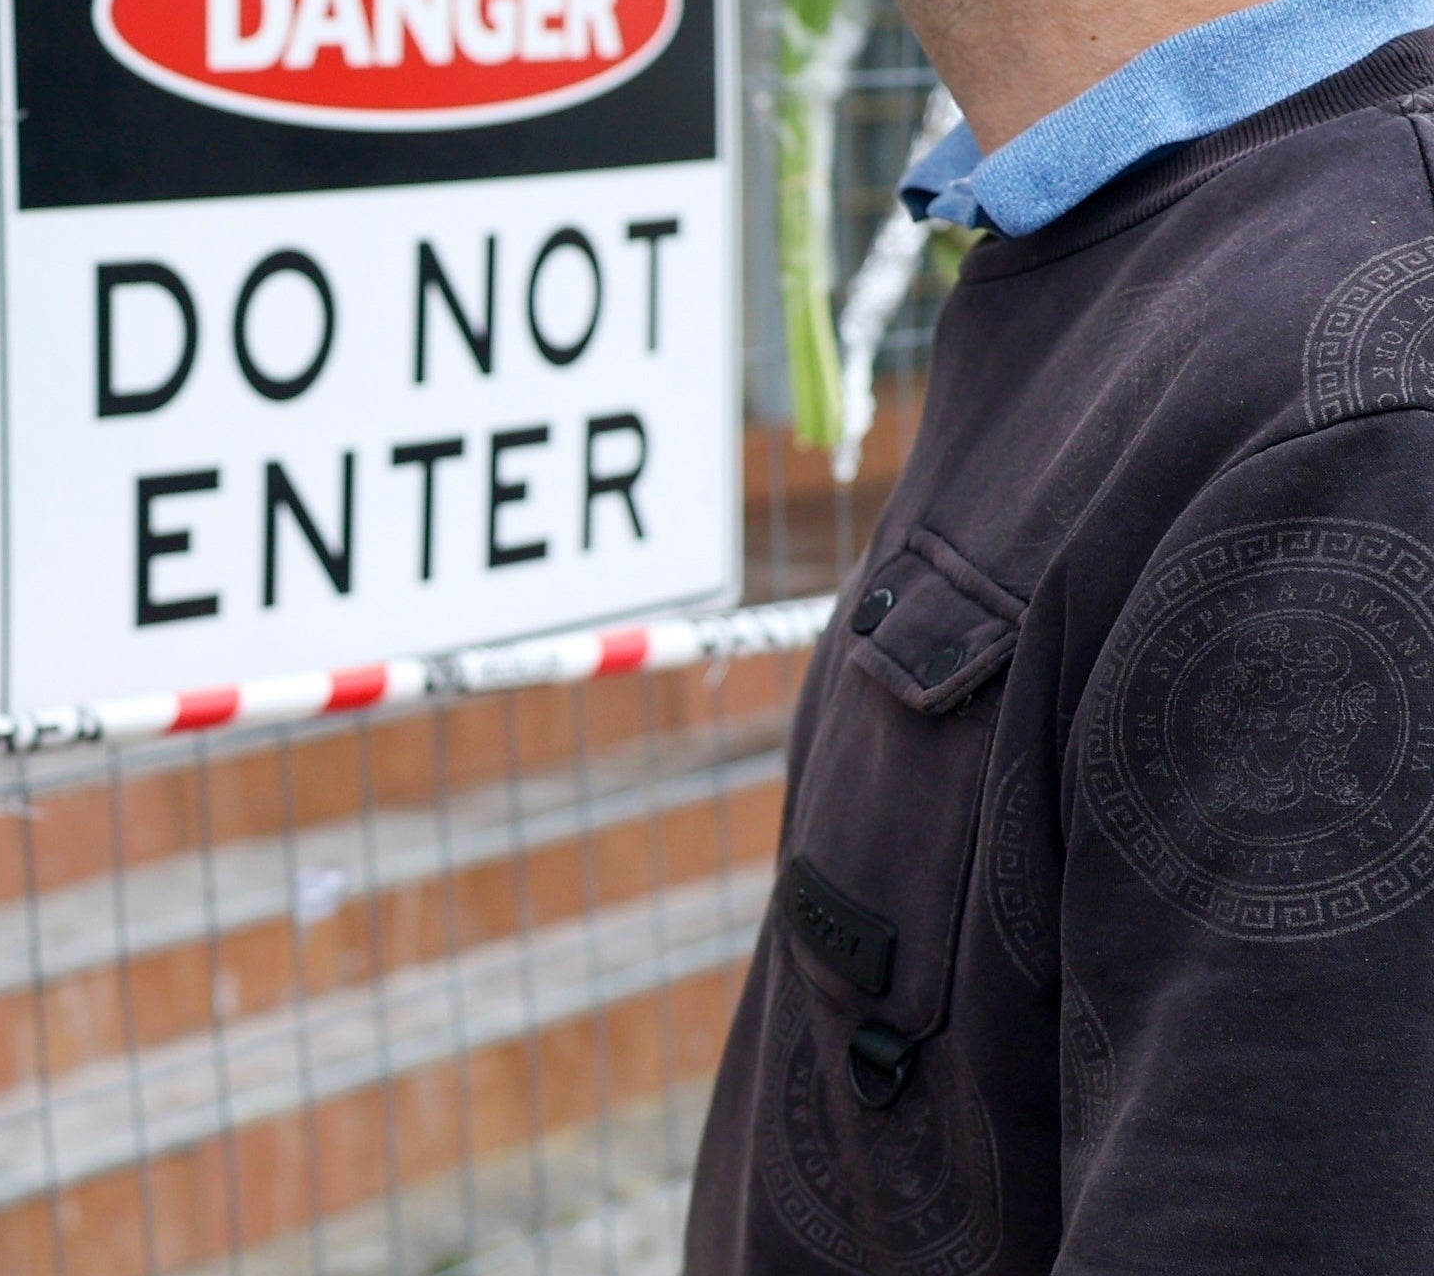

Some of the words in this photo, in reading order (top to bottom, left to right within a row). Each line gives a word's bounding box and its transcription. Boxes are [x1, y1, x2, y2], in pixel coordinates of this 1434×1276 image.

[93, 246, 336, 419] DO
[414, 217, 682, 387] NOT
[1373, 316, 1414, 380] YORK
[134, 411, 648, 630] ENTER
[1150, 589, 1258, 681] SUPPLY
[1277, 583, 1298, 603] &
[1314, 582, 1431, 682] DEMAND
[1162, 786, 1226, 864] YORK
[1231, 847, 1307, 875] CITY
